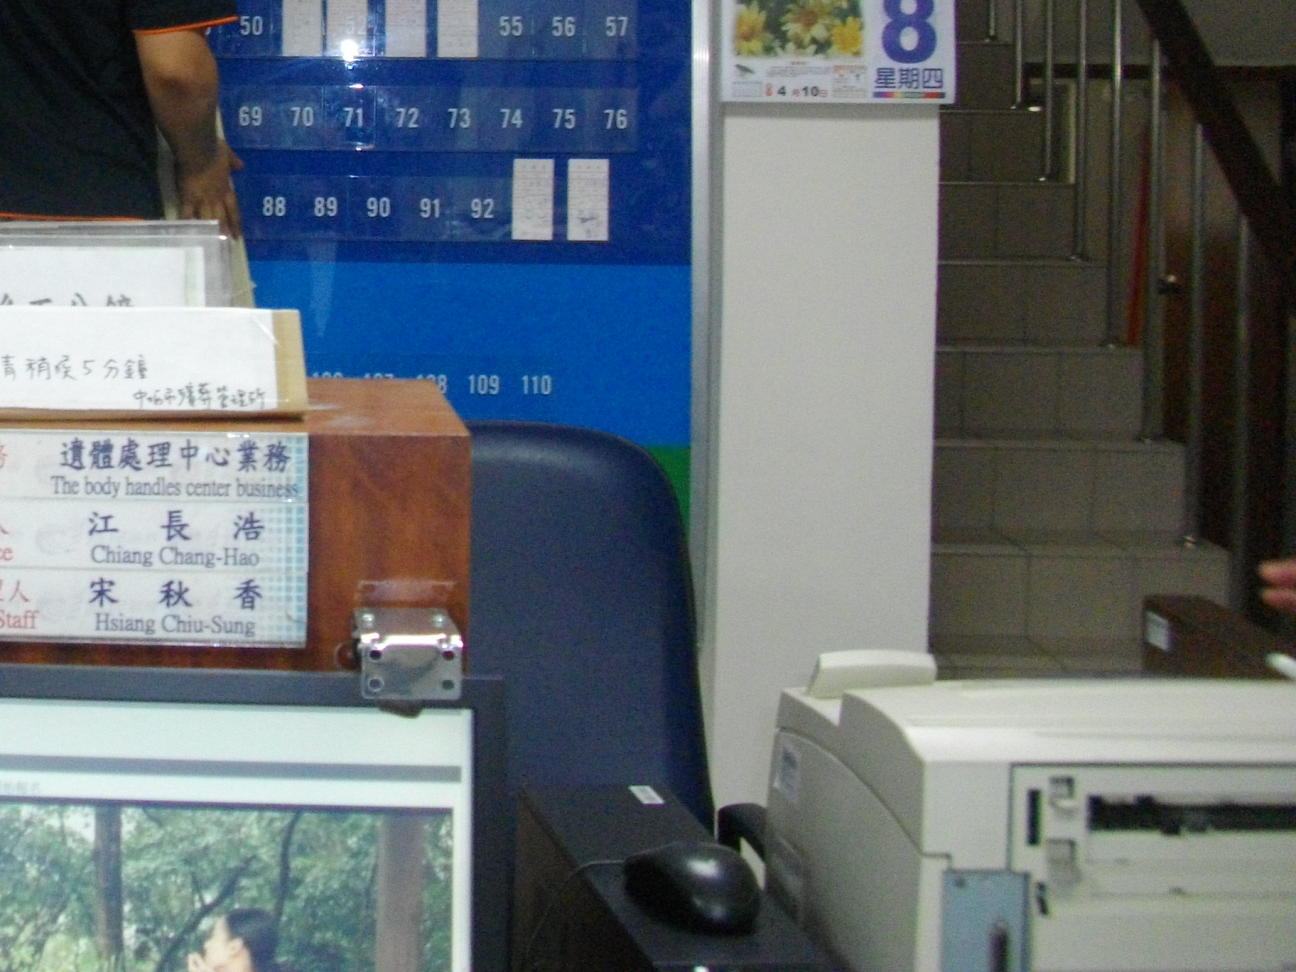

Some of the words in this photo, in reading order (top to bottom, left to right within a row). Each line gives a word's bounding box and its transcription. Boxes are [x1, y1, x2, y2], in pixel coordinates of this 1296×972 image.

[238, 14, 264, 37] 50
[498, 14, 524, 38] 55
[551, 14, 577, 38] 56
[604, 14, 630, 38] 57
[874, 67, 944, 90] 星期四
[237, 104, 264, 128] 69
[289, 105, 316, 128] 70
[342, 105, 365, 129] 71
[394, 106, 420, 129] 72
[447, 106, 473, 130] 73
[499, 107, 524, 130] 74
[551, 107, 578, 131] 75
[603, 107, 630, 131] 76
[261, 195, 287, 218] 88
[312, 195, 339, 218] 89
[365, 195, 392, 219] 90
[418, 196, 442, 220] 91
[469, 196, 496, 220] 92
[467, 373, 501, 396] 109
[520, 373, 554, 396] 110
[60, 437, 291, 473] 遺體處理中心業務
[51, 475, 80, 496] The
[84, 476, 119, 499] body
[125, 477, 181, 496] handles
[186, 481, 230, 497] center
[236, 478, 300, 499] business
[88, 509, 265, 542] 江長浩
[91, 544, 153, 568] Chiang
[159, 546, 260, 569] Chang-Hao
[88, 577, 263, 611] 宋秋香
[95, 612, 155, 636] Hsiang
[161, 614, 256, 637] Chiu-Sung
